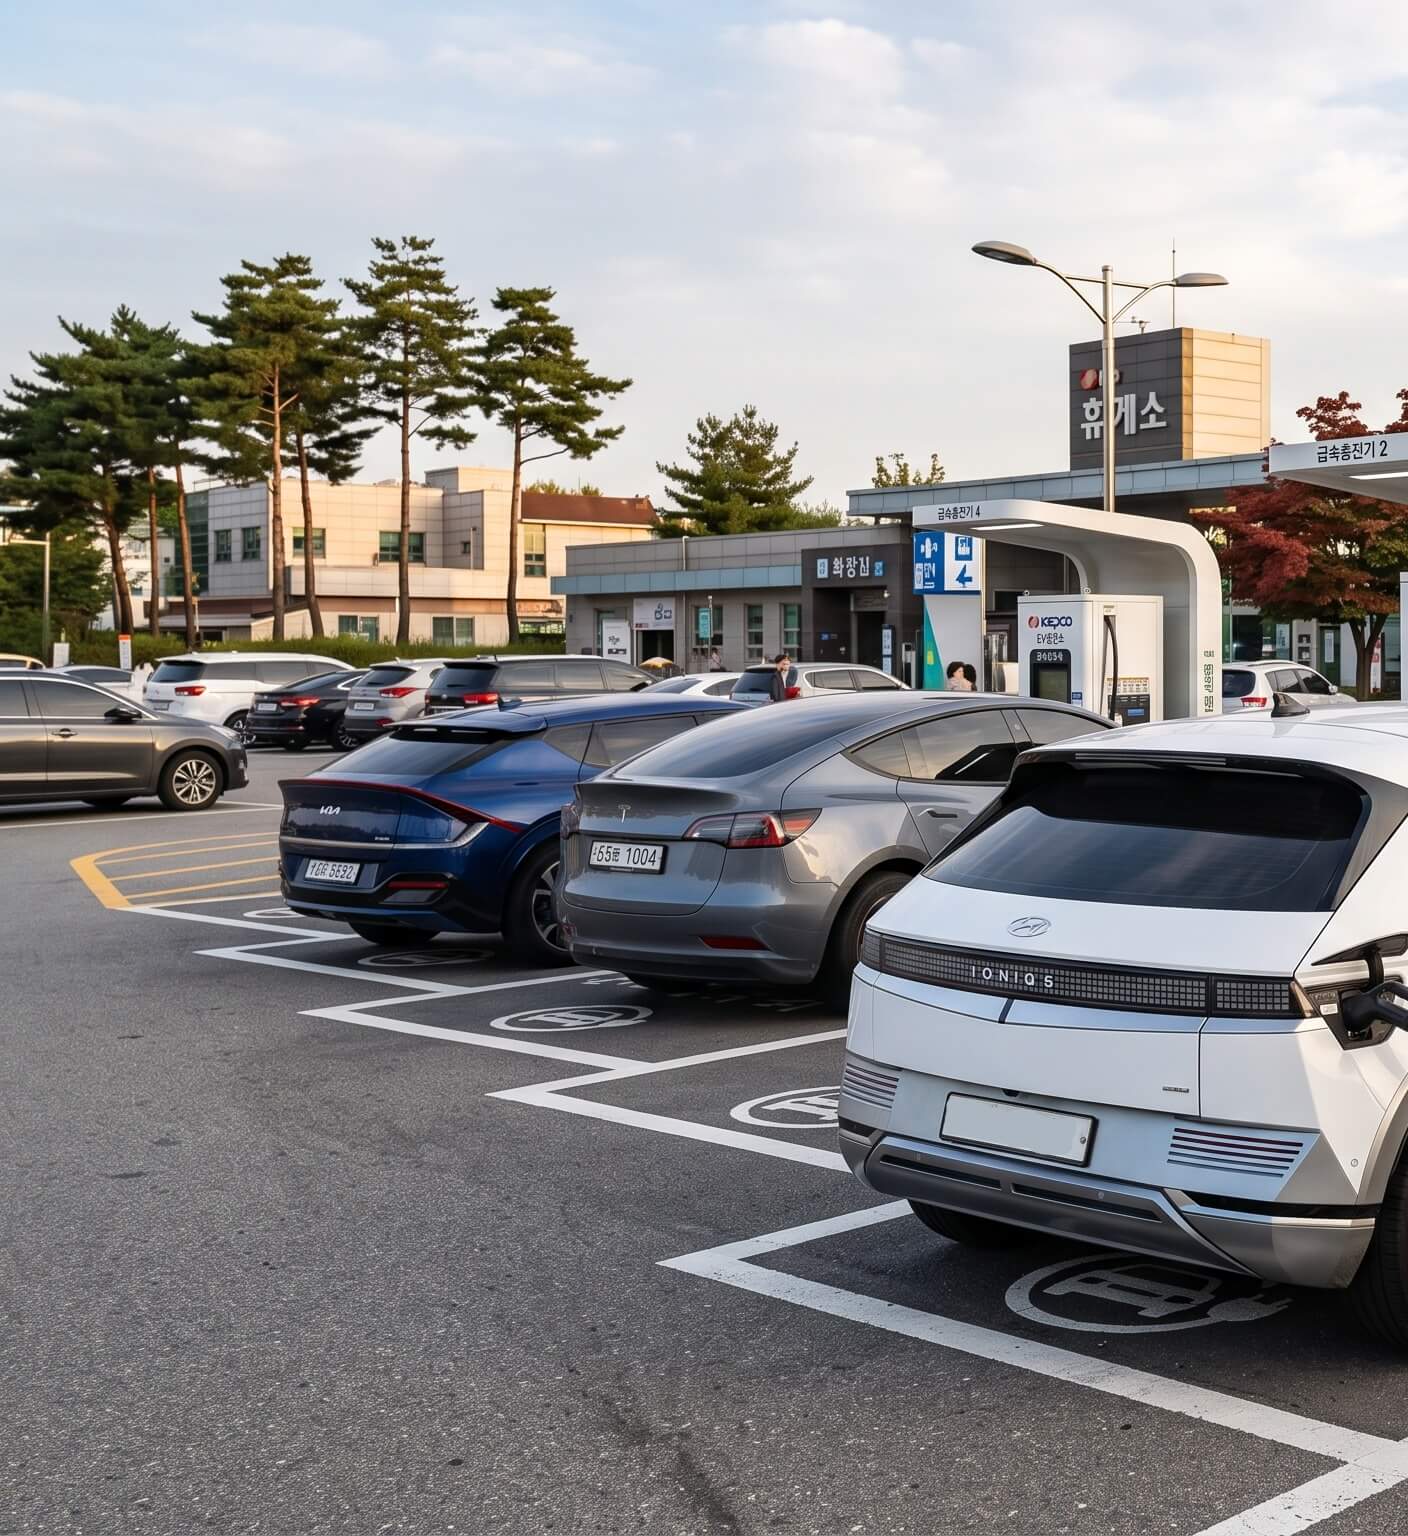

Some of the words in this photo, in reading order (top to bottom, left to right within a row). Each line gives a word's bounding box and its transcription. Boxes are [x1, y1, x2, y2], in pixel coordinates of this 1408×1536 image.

[1379, 440, 1388, 457] 2
[1041, 616, 1073, 630] KEPCO
[626, 847, 657, 867] 1004
[972, 965, 1035, 986] IONIQ
